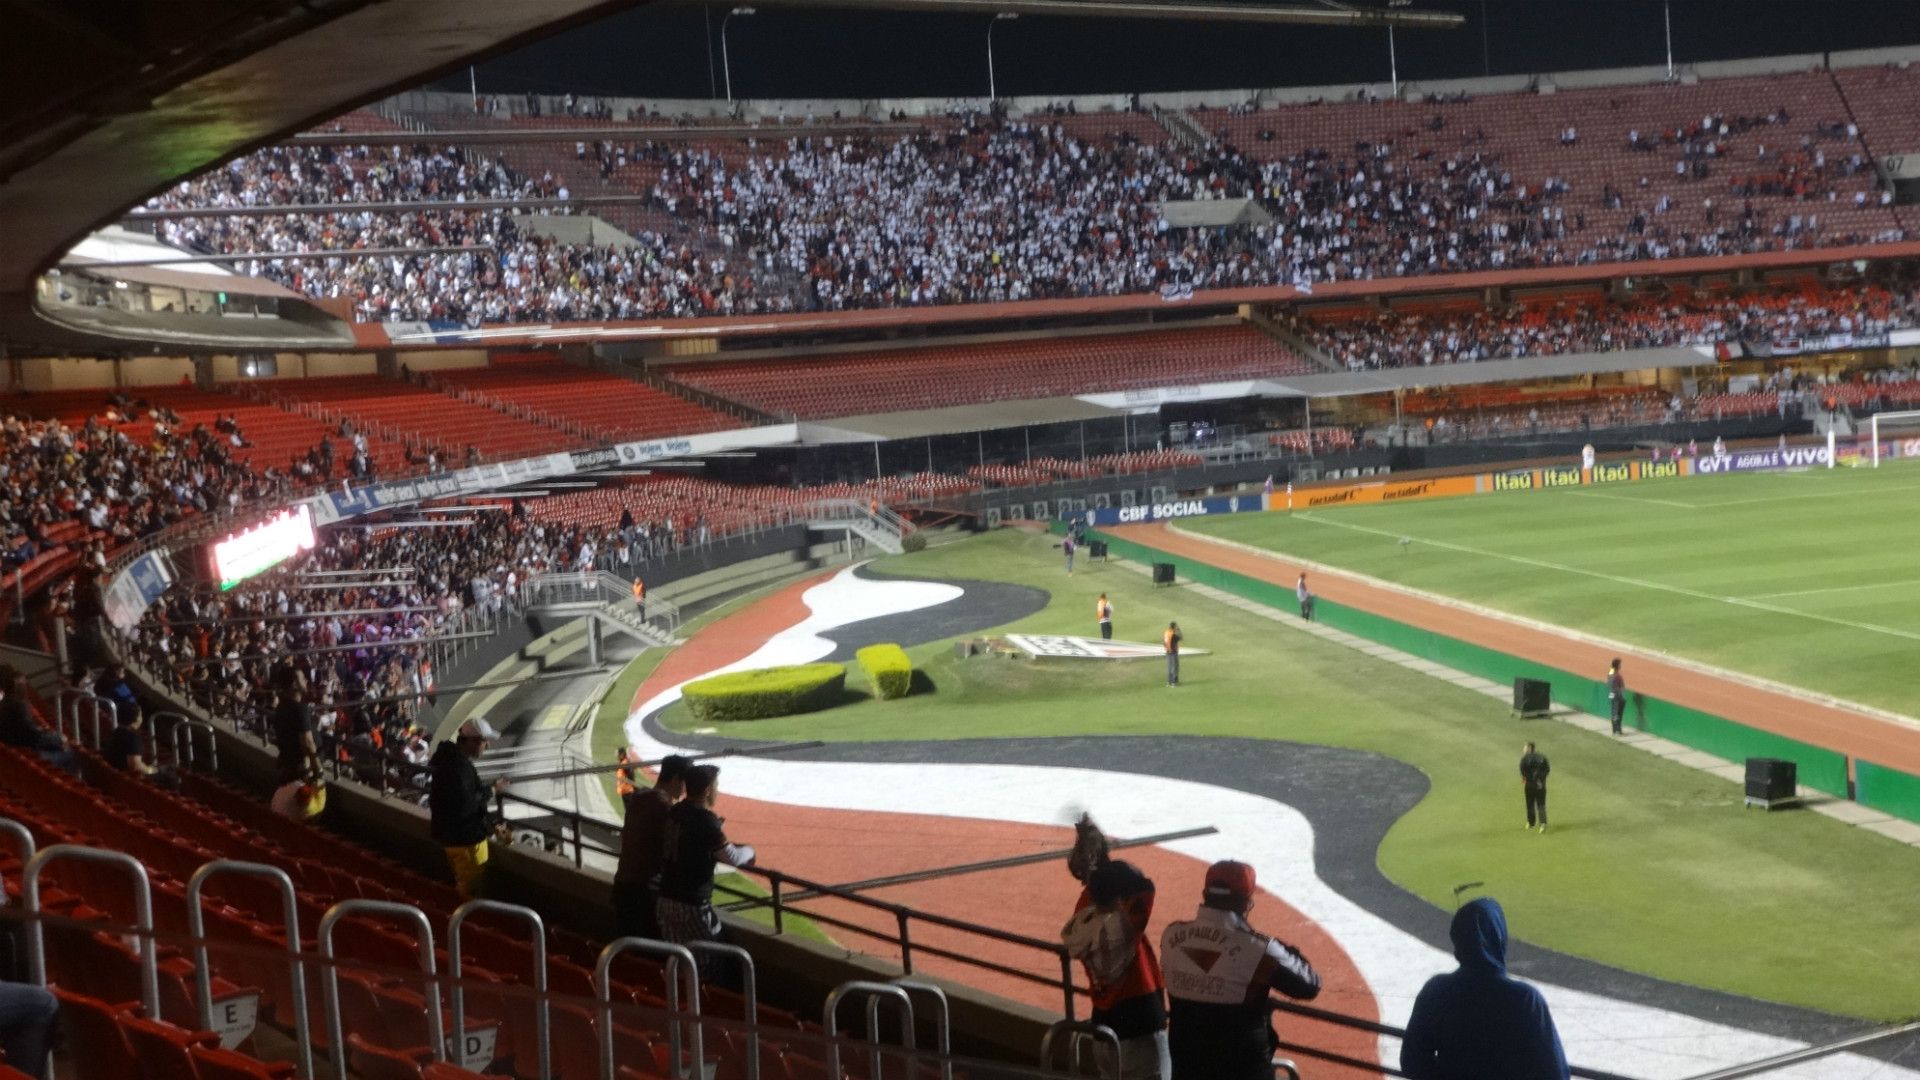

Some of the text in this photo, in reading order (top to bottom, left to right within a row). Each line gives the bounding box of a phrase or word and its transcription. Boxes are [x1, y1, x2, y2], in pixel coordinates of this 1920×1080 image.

[1886, 155, 1904, 172] 07
[1699, 455, 1732, 473] GVT
[1737, 455, 1770, 469] AGORA
[1782, 447, 1829, 466] VIVO
[1495, 460, 1677, 490] Itaú Itaú Itaú Itaú
[1118, 500, 1208, 522] CBF SOCIAL
[1188, 925, 1221, 942] PAULO
[225, 1004, 238, 1024] E
[466, 1036, 481, 1056] D
